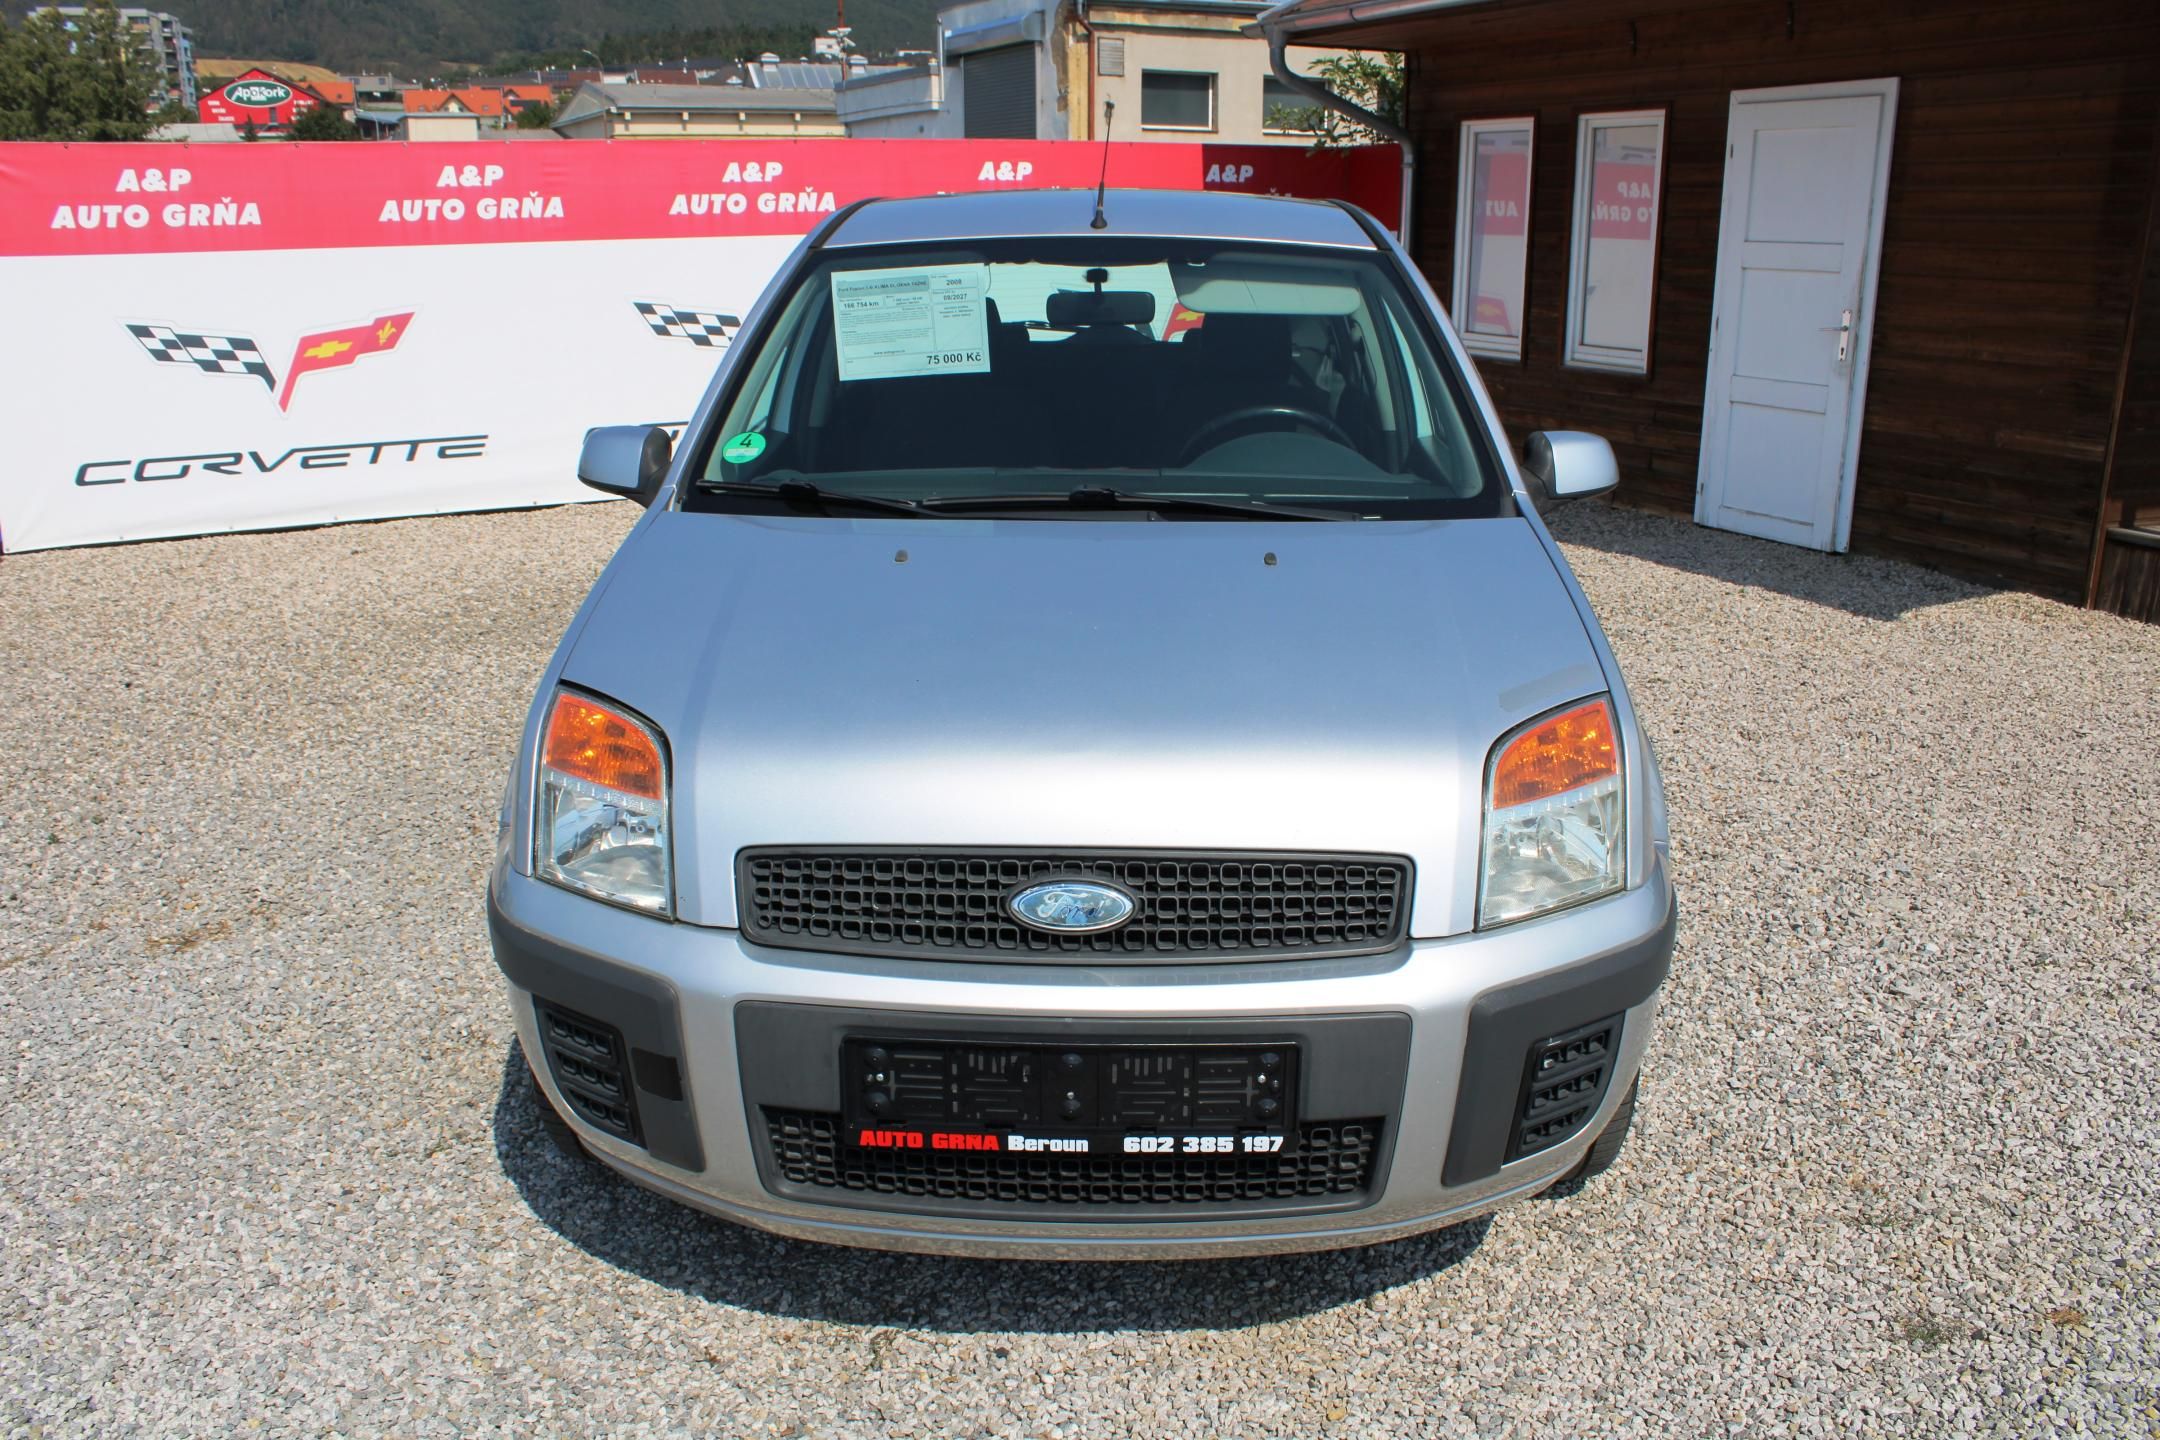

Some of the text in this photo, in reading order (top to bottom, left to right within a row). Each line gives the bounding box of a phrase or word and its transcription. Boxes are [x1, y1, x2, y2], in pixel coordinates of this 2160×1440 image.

[115, 168, 192, 192] A&P
[436, 165, 504, 187] A&P
[722, 162, 783, 183] A&P
[977, 161, 1033, 181] A&P
[1205, 164, 1254, 183] A&P
[378, 191, 564, 222] AUTO GRŇA
[669, 186, 836, 215] AUTO GRŇA
[50, 197, 262, 229] AUTO GRŇA
[927, 351, 982, 365] 75 000 Kč
[739, 433, 752, 448] 4
[75, 434, 489, 487] CORVETTE
[1037, 891, 1106, 919] Ford
[859, 1130, 923, 1148] AUTO
[1007, 1134, 1089, 1153] Beroun
[1123, 1135, 1174, 1153] 602
[1183, 1136, 1234, 1153] 385
[1242, 1136, 1284, 1153] 197
